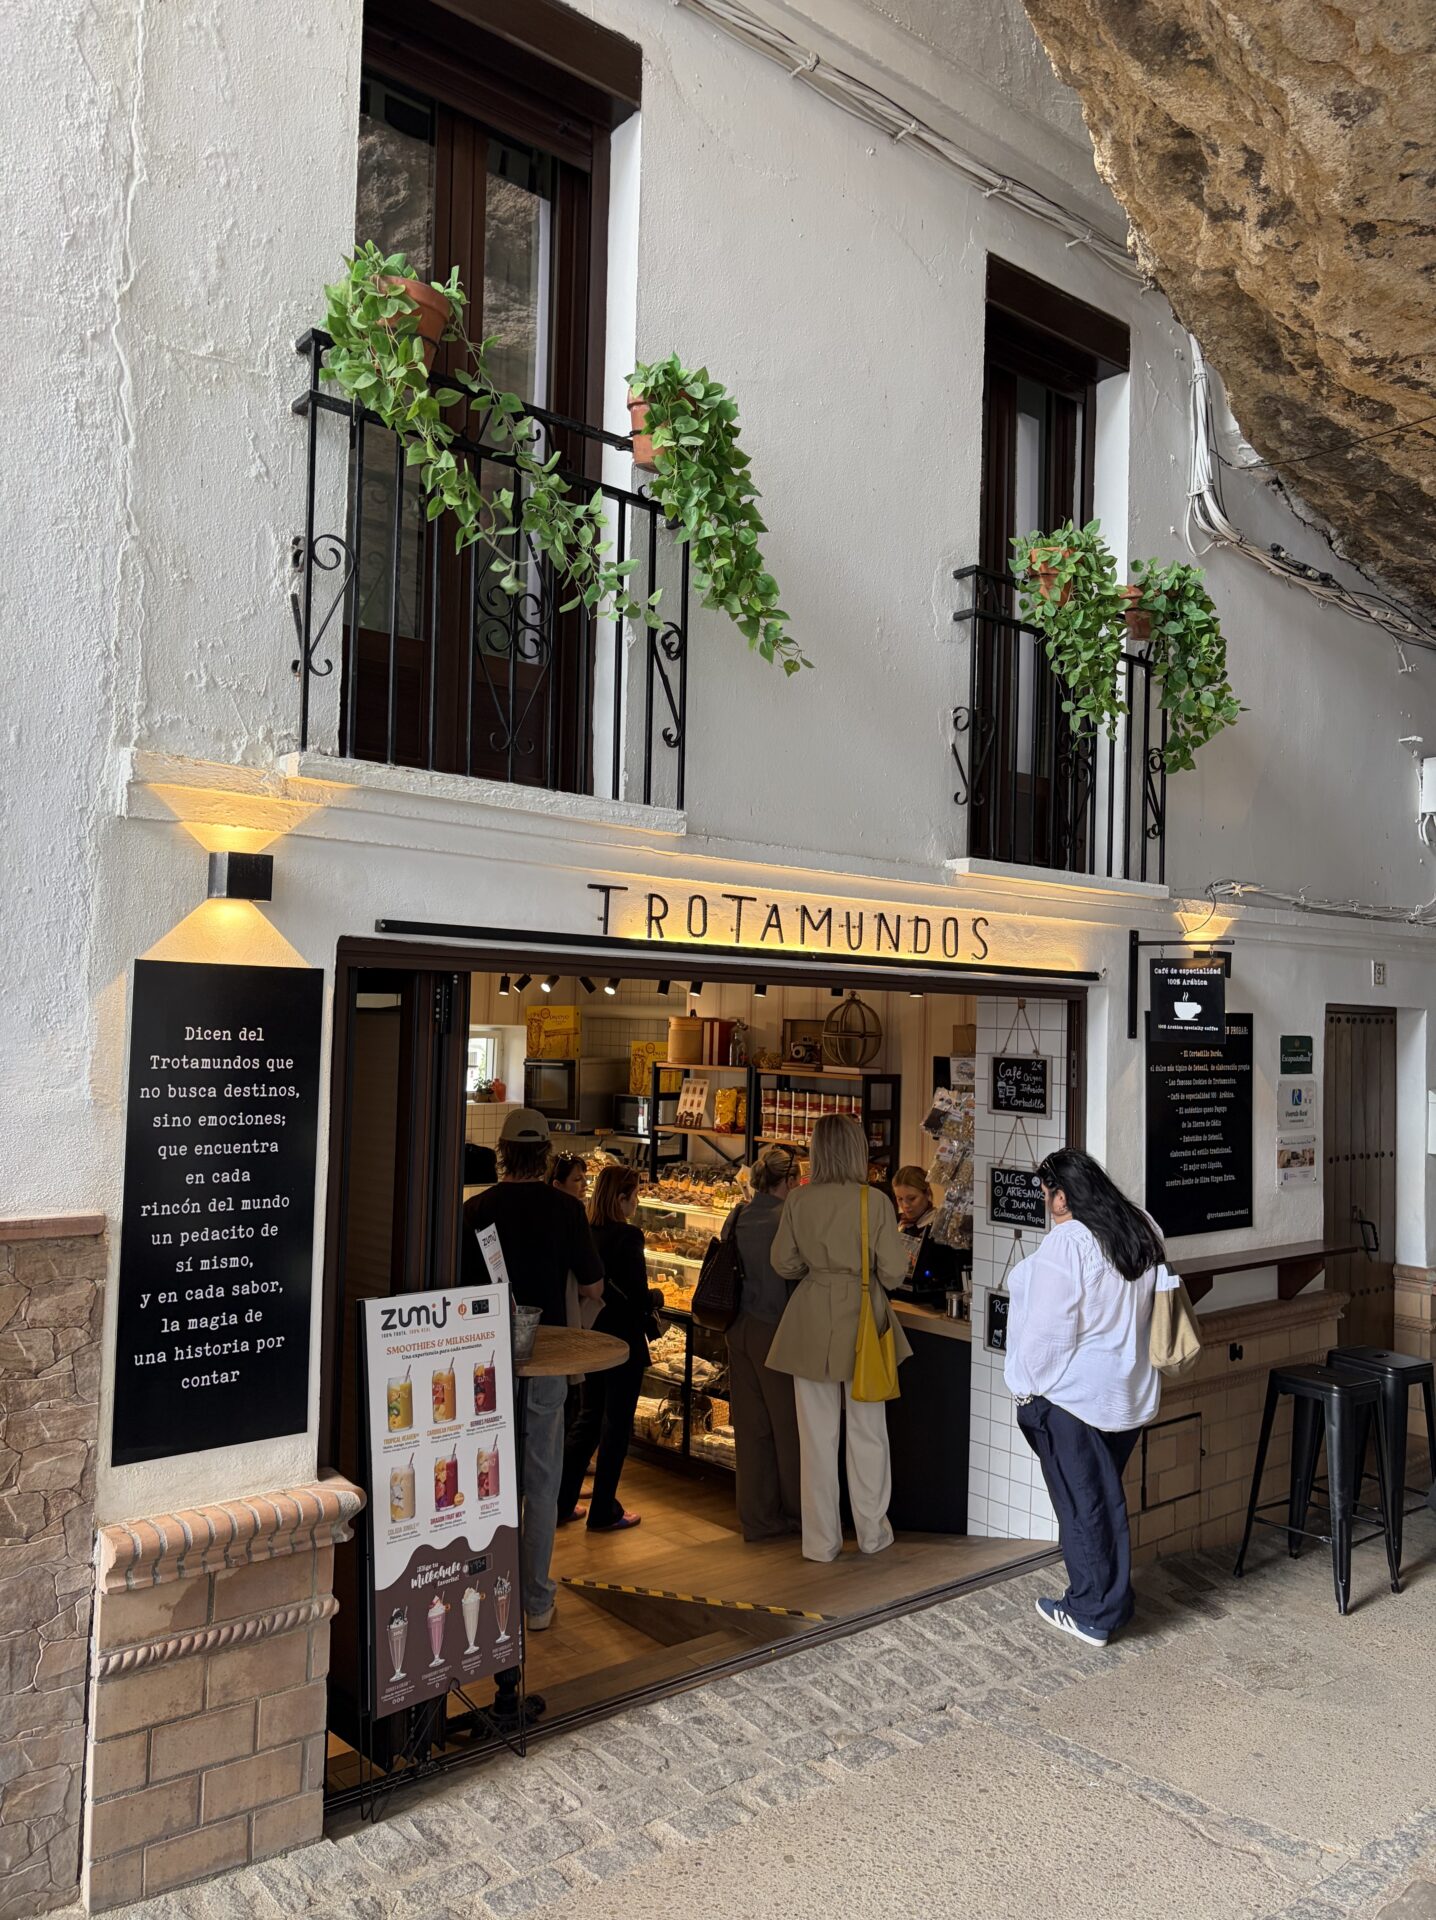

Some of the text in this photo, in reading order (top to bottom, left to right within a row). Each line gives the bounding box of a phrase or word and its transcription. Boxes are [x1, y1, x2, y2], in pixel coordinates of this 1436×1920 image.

[587, 884, 990, 960] TROTAMUNDOS
[1154, 967, 1169, 975] Café
[1179, 967, 1221, 975] especialidad
[1182, 978, 1208, 986] Arábica
[184, 1026, 264, 1041] Dicen del
[150, 1055, 293, 1072] Trotamundos que
[999, 1062, 1022, 1081] Café
[140, 1083, 299, 1098] no busca destinos,
[1010, 1096, 1045, 1109] Cortadillo
[153, 1112, 286, 1128] sino emociones;
[158, 1139, 278, 1160] que encuentra
[185, 1168, 250, 1185] en cada
[995, 1171, 1026, 1185] DULCES
[1006, 1187, 1045, 1200] ARTESANOS
[141, 1194, 290, 1216] rincón del mundo
[1011, 1200, 1036, 1209] DURÁN
[994, 1208, 1044, 1224] Elaboración Propia
[151, 1223, 278, 1247] un pedacito de
[176, 1256, 253, 1272] sí mismo,
[140, 1280, 283, 1309] y en cada sabor,
[161, 1309, 262, 1333] la magia de
[134, 1336, 285, 1366] una historia por
[386, 1331, 495, 1355] SMOOTHIES & MILKSHAKES
[181, 1370, 240, 1389] contar
[411, 1561, 460, 1589] Milkshake
